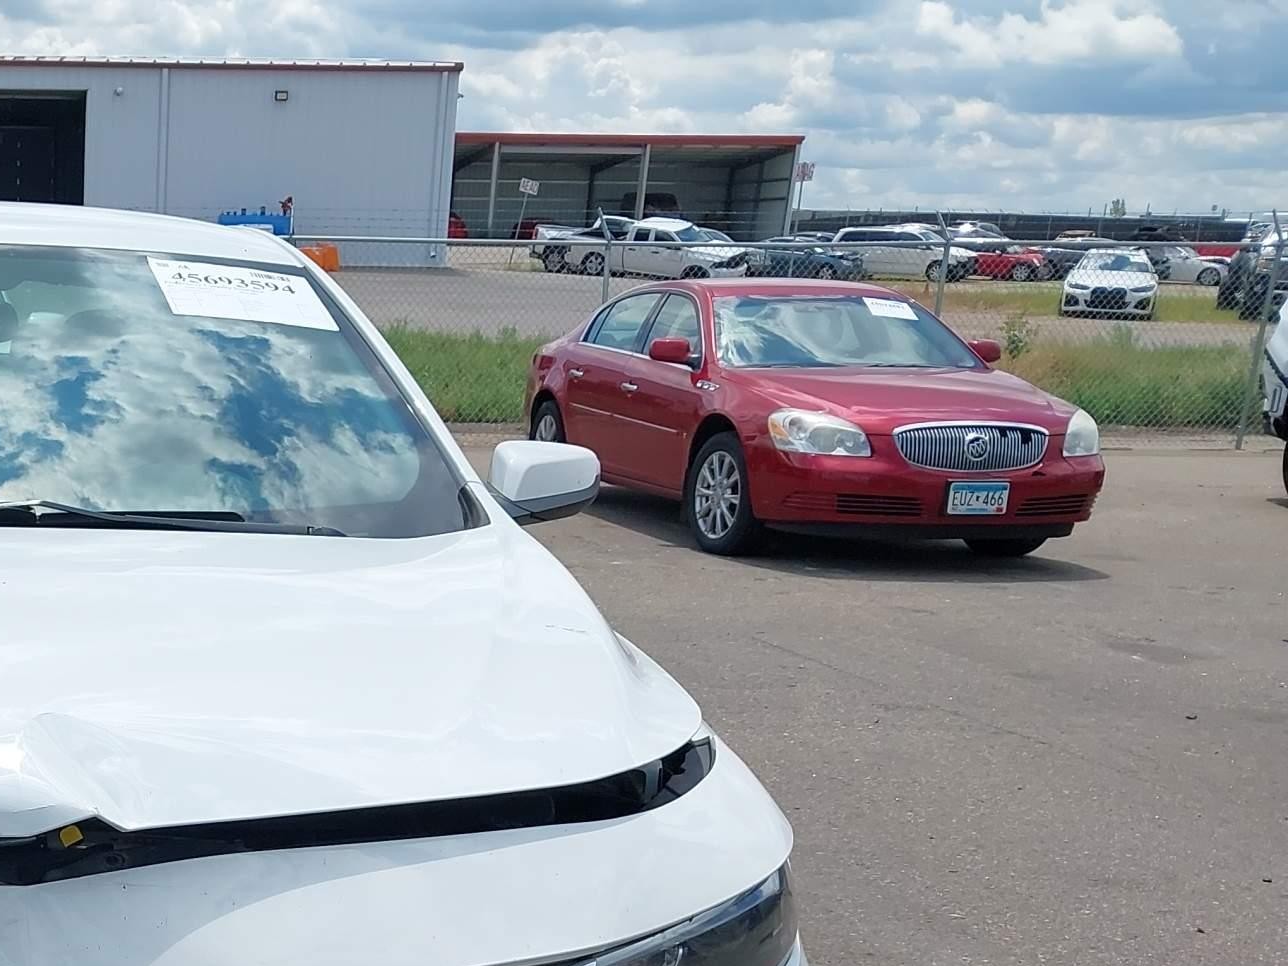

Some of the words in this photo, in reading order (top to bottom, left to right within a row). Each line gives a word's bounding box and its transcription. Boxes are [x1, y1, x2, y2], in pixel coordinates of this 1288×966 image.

[172, 272, 297, 295] 45693594
[952, 491, 975, 506] EUZ
[982, 490, 1004, 506] 466
